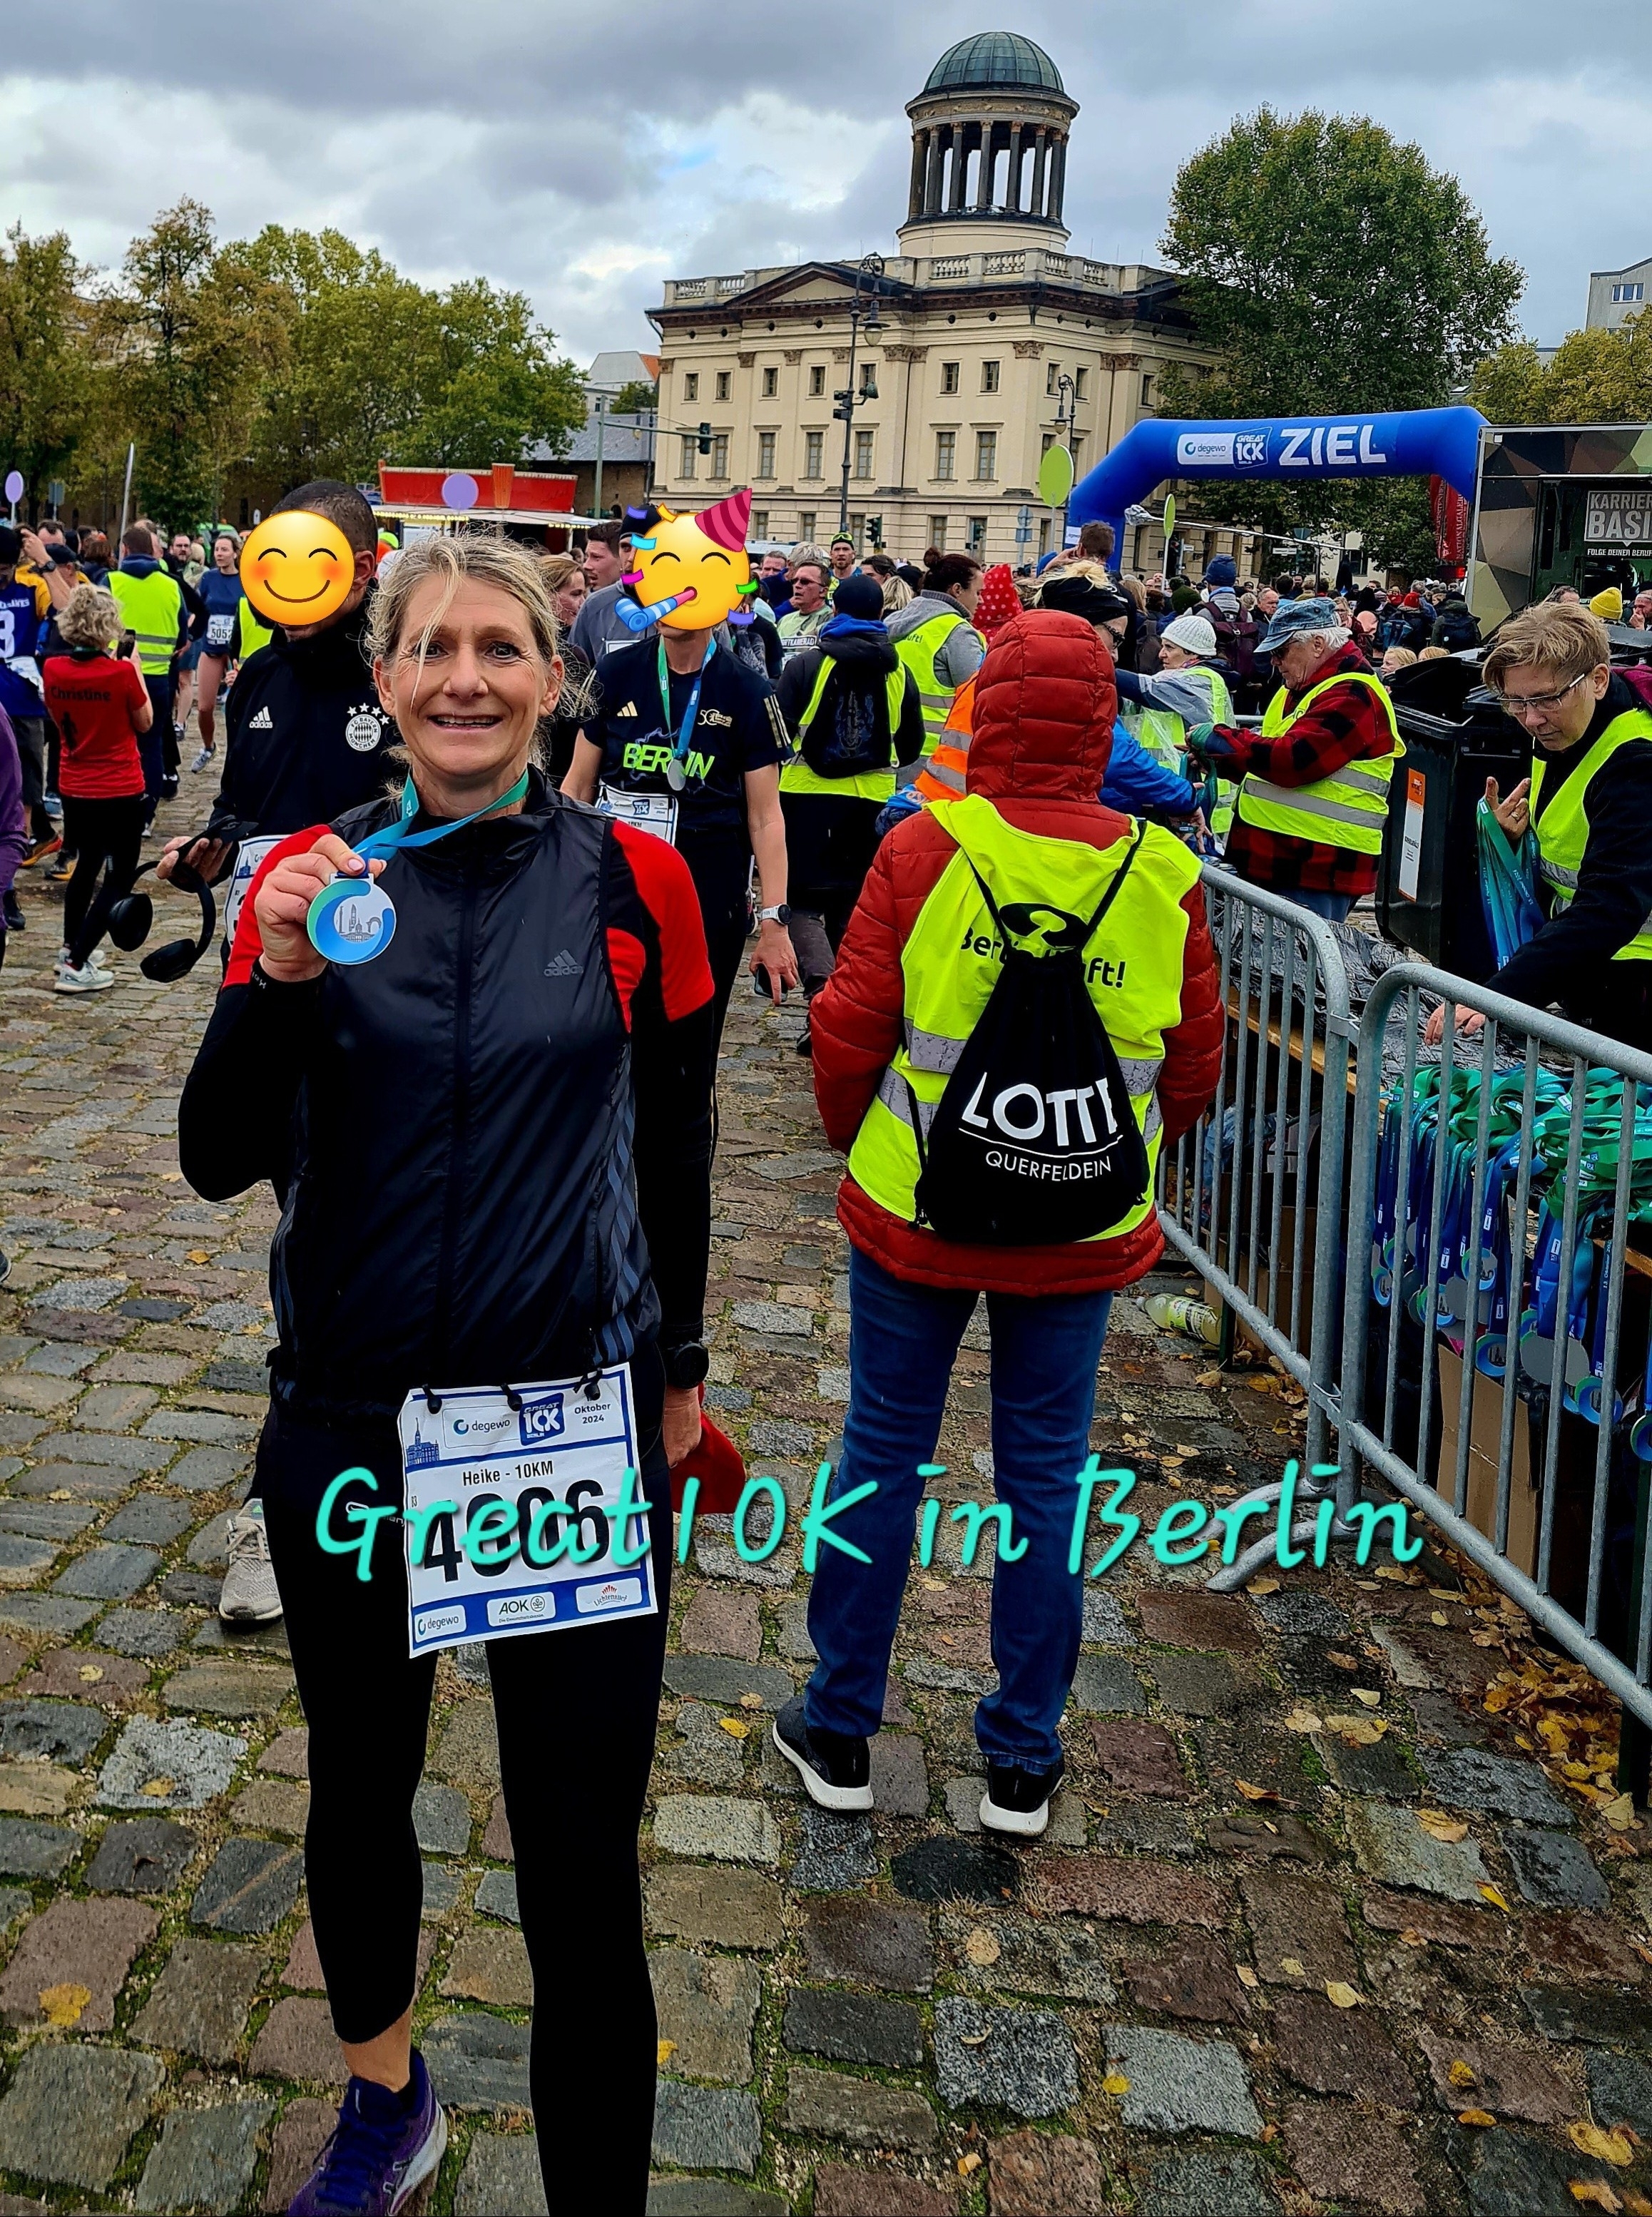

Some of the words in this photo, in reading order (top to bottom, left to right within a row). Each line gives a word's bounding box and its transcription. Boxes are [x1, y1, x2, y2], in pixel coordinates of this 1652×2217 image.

[1236, 434, 1265, 443] GREAT
[1278, 425, 1387, 466] ZIEL
[1198, 444, 1226, 455] degewo
[50, 686, 111, 702] Christine
[360, 717, 378, 733] BAYERN
[623, 743, 715, 780] BERIN
[544, 965, 583, 977] adidas
[986, 1150, 1112, 1182] QUERFELDEIN
[574, 1402, 611, 1415] Oktober
[471, 1419, 511, 1433] degewo
[582, 1415, 605, 1425] 2024
[463, 1467, 501, 1487] Heike
[515, 1460, 554, 1479] 10KM
[499, 1599, 529, 1616] AOK
[428, 1614, 459, 1630] degewo
